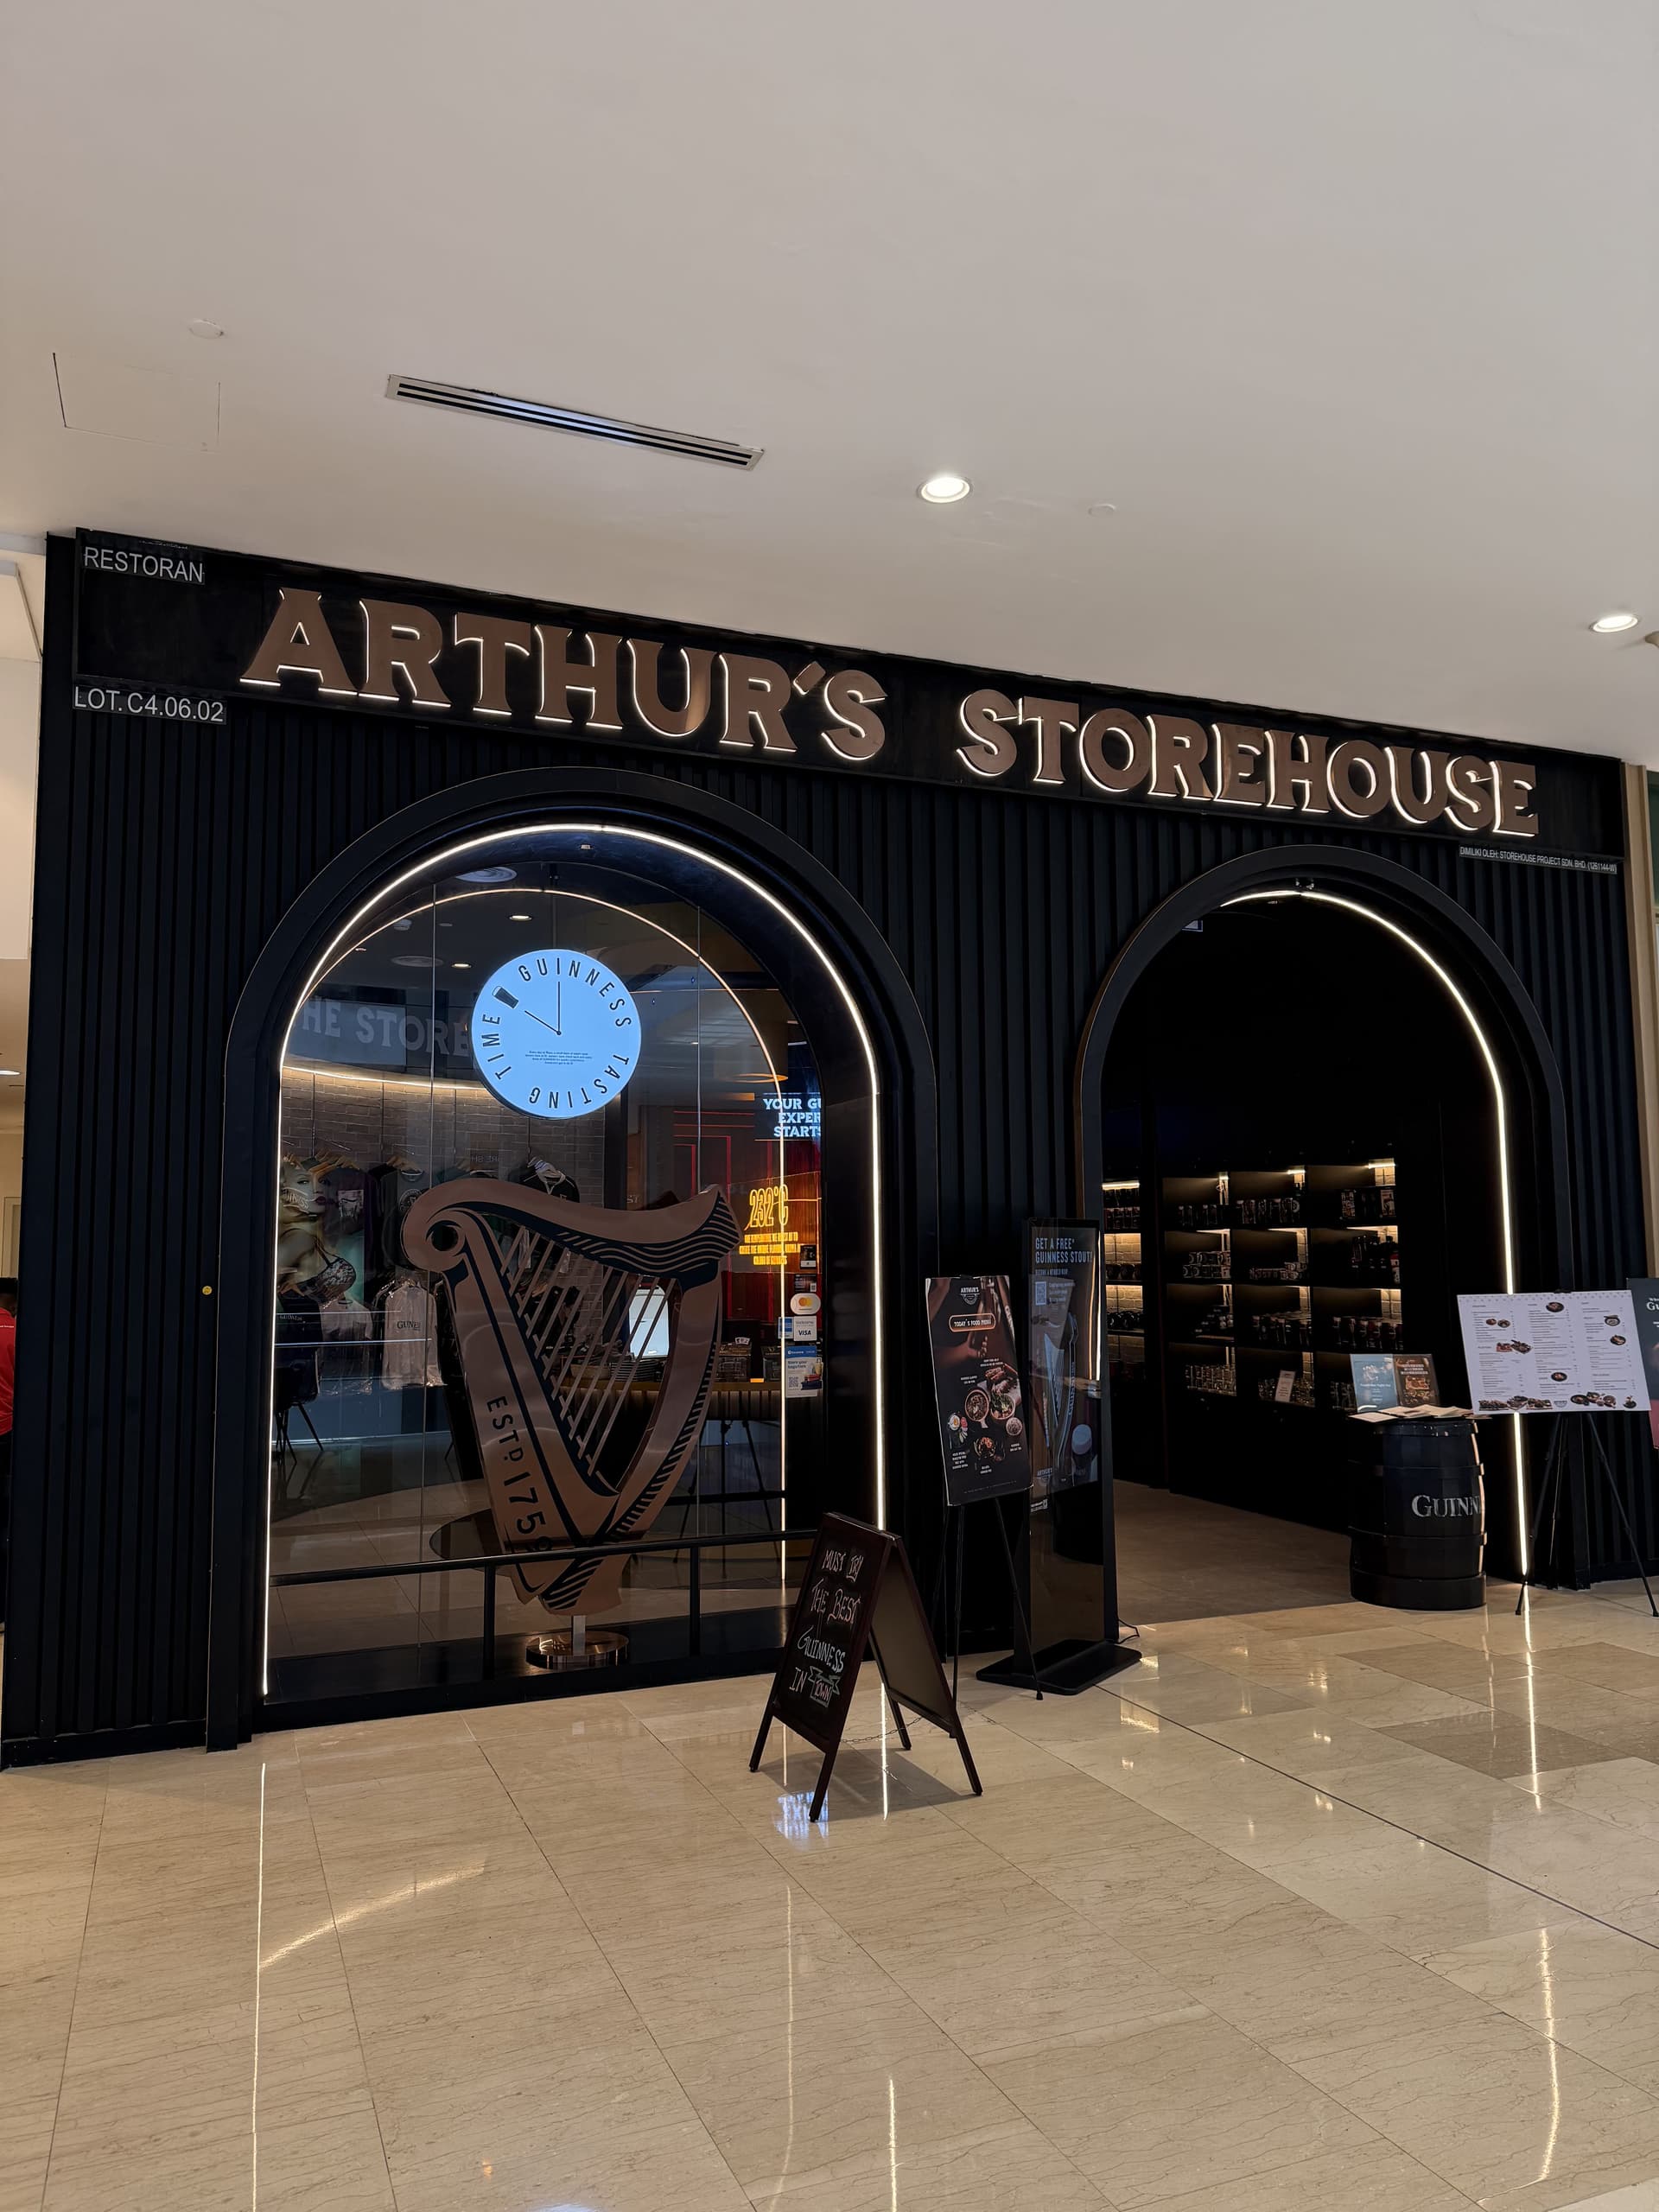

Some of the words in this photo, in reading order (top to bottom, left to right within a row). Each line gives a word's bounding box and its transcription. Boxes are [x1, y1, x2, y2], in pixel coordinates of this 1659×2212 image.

[85, 546, 203, 583] RESTORAN
[74, 686, 123, 712] LOT.
[127, 692, 224, 722] C4.06.02
[239, 588, 887, 760] ARTHUR'S
[956, 689, 1540, 837] STOREHOUSE
[1499, 850, 1536, 863] STOREHOUSE
[1537, 855, 1561, 866] PROJECT
[518, 957, 632, 1027] GUINNESS
[480, 1014, 512, 1080] TIME
[529, 1054, 630, 1109] TASTING
[762, 1097, 802, 1110] YOUR
[1035, 1237, 1047, 1250] GET
[1050, 1238, 1054, 1250] A
[1035, 1251, 1069, 1263] GUINNESS
[821, 1548, 847, 1573] MUST
[848, 1554, 864, 1579] TRY
[810, 1577, 830, 1613] THE
[827, 1588, 861, 1624] BEST
[797, 1624, 846, 1674] GUINNESS
[789, 1666, 808, 1693] IN
[814, 1679, 832, 1702] TOWN
